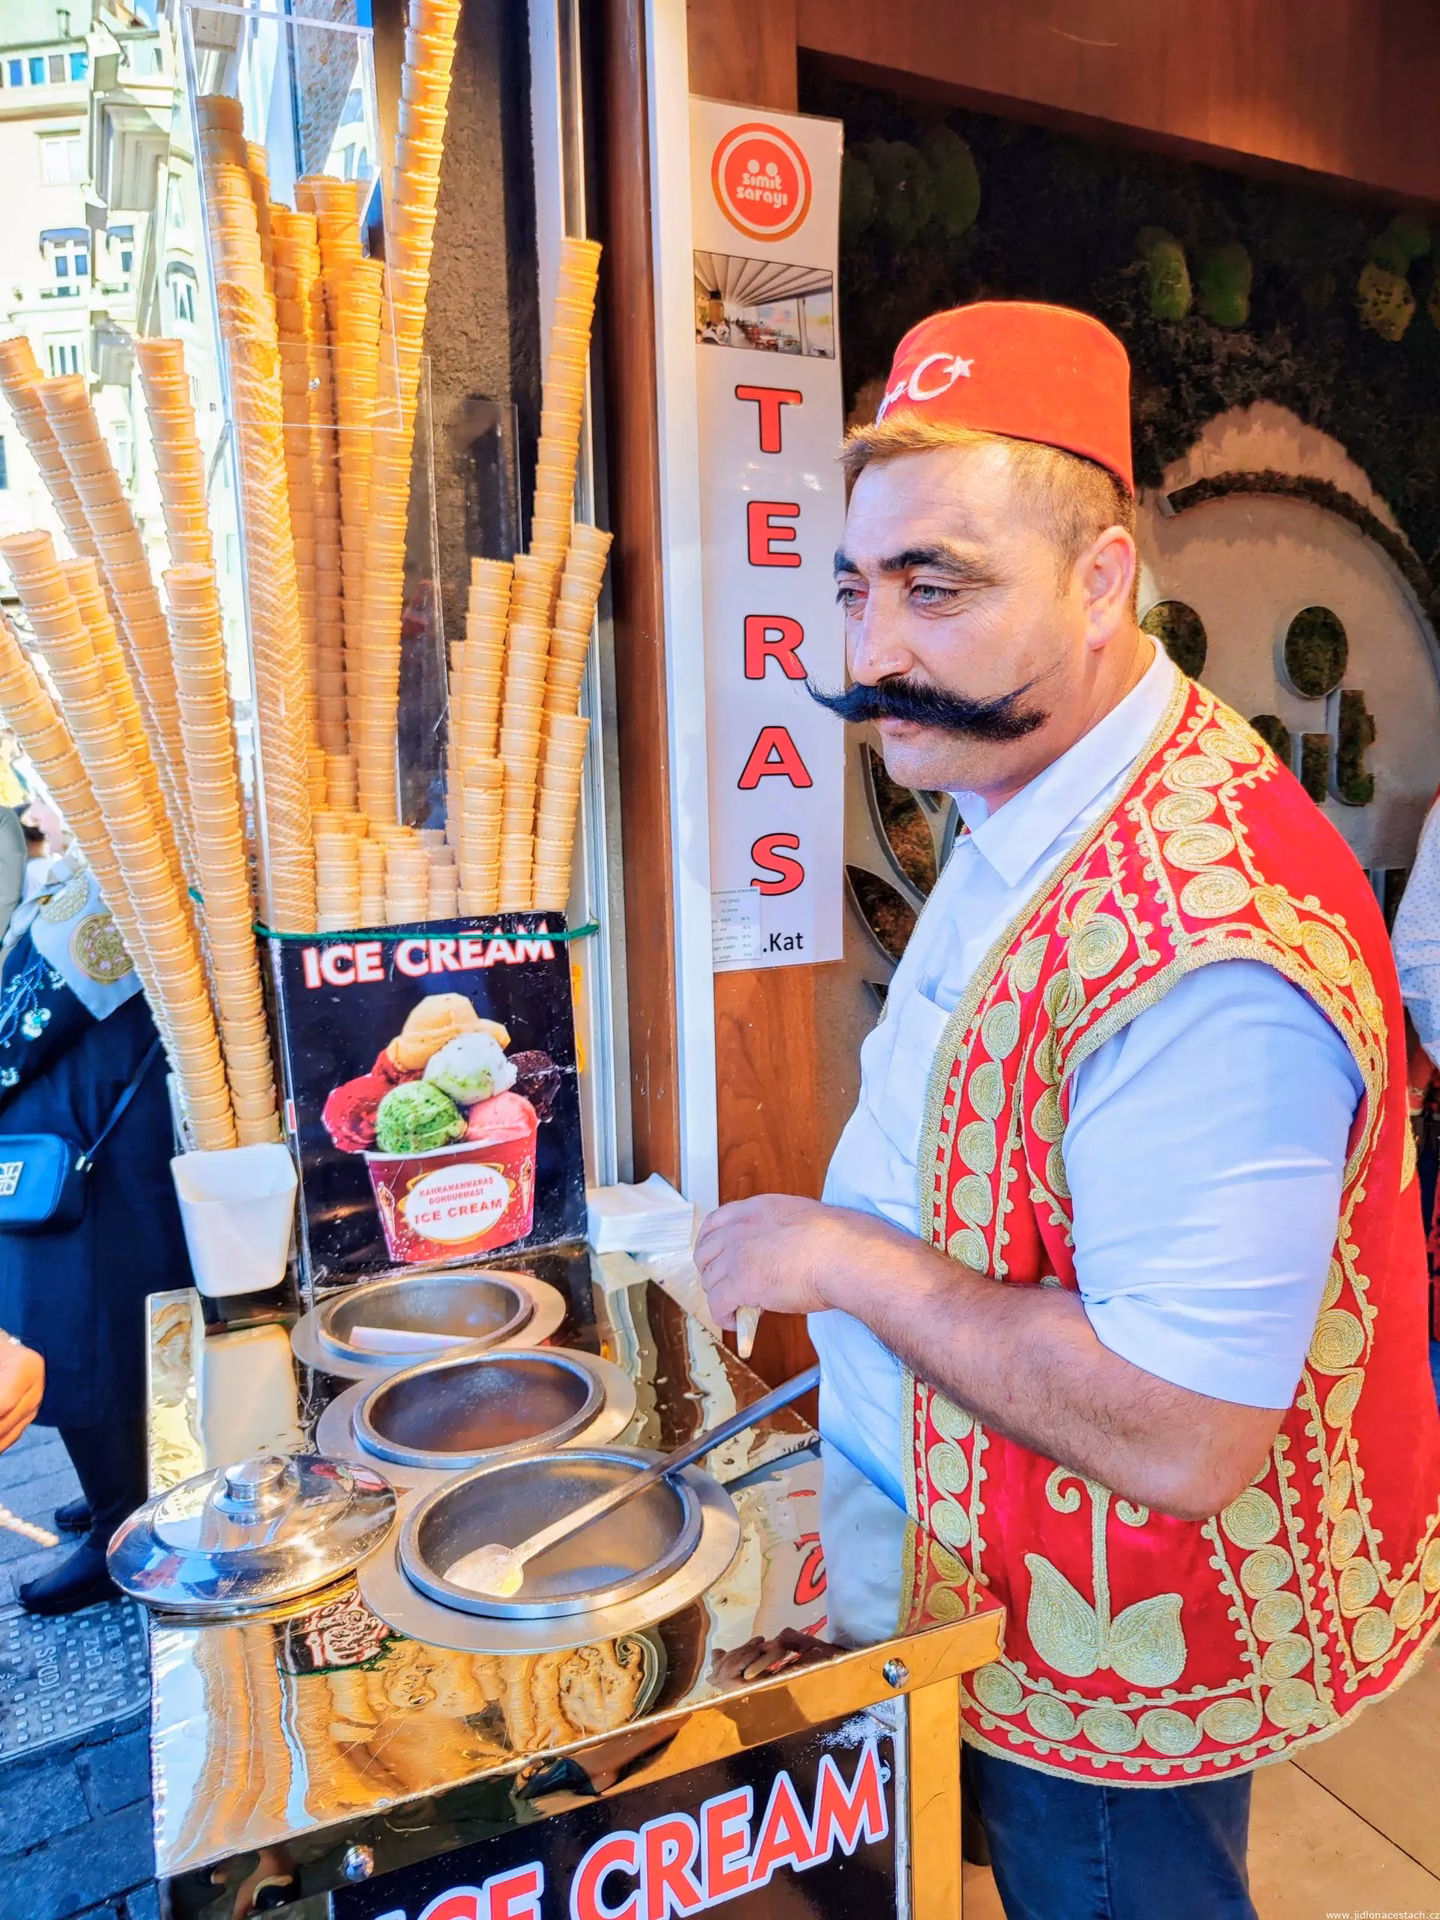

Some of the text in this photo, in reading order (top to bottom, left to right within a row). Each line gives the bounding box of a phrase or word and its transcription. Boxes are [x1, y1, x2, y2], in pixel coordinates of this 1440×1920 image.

[735, 384, 813, 896] TERAS
[302, 921, 555, 988] ICE CREAM
[415, 1198, 503, 1225] ICE CREAM
[429, 1188, 484, 1205] DONDURMASI
[571, 1737, 889, 1920] CREAM
